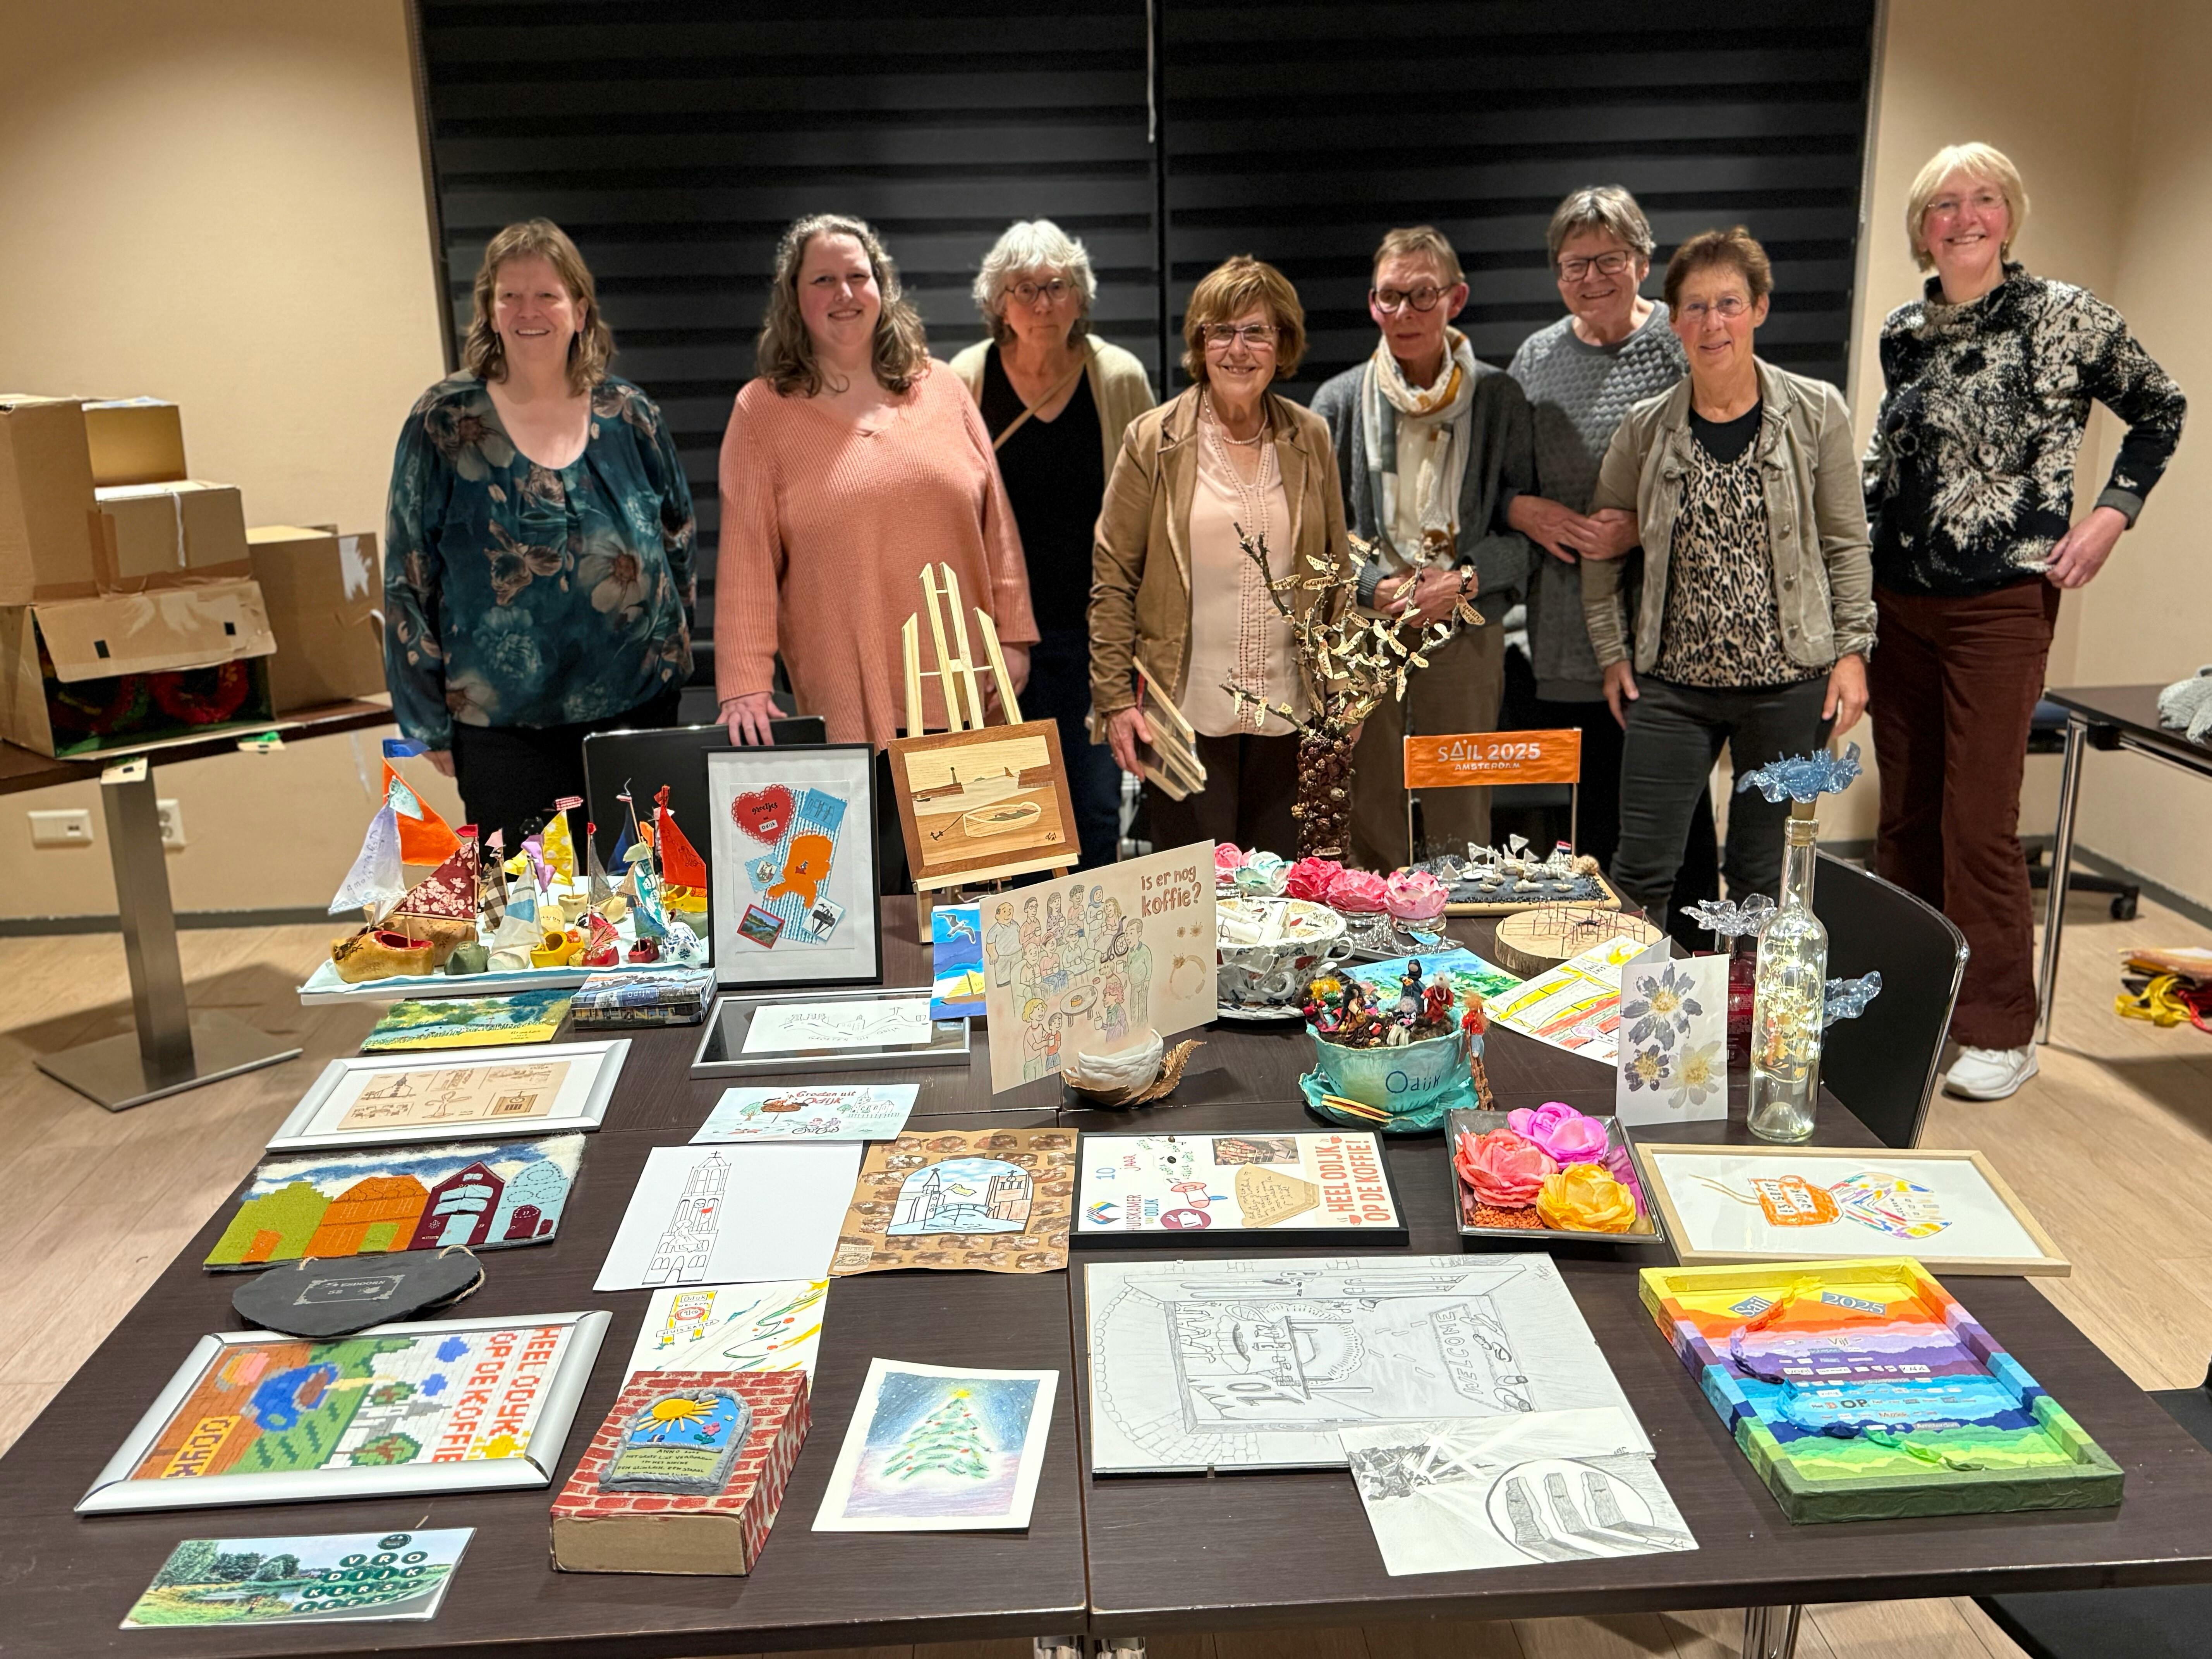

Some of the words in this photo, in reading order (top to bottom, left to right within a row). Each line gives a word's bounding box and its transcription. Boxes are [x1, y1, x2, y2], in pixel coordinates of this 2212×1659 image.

[1437, 739, 1483, 762] SAIL
[1487, 743, 1541, 761] 2025
[1454, 761, 1521, 771] AMSTERDAM
[752, 802, 778, 815] groetjes
[1141, 875, 1152, 891] is
[1156, 871, 1170, 886] er
[1174, 865, 1196, 884] nog
[1141, 881, 1202, 918] koffie?
[1385, 1070, 1441, 1094] Odijk
[1315, 1145, 1348, 1180] ODIJK
[1345, 1140, 1380, 1183] KOFFIE!
[1096, 1167, 1116, 1180] 10
[1323, 1182, 1355, 1212] HEEL
[1357, 1186, 1385, 1201] DE
[1144, 1199, 1159, 1216] ODIJK
[1362, 1204, 1391, 1221] OP
[1734, 1296, 1771, 1317] Sail
[1826, 1293, 1885, 1314] 2025
[485, 1333, 518, 1358] OP
[517, 1326, 562, 1371] HEEL
[1435, 1310, 1484, 1395] WELCOME
[1827, 1338, 1849, 1346] Vijf
[468, 1361, 506, 1386] DE
[431, 1389, 493, 1463] KOFFIE
[349, 1553, 422, 1565] VRO
[328, 1568, 421, 1581] DIJK
[309, 1581, 417, 1596] KERST
[301, 1592, 407, 1611] FEEST
